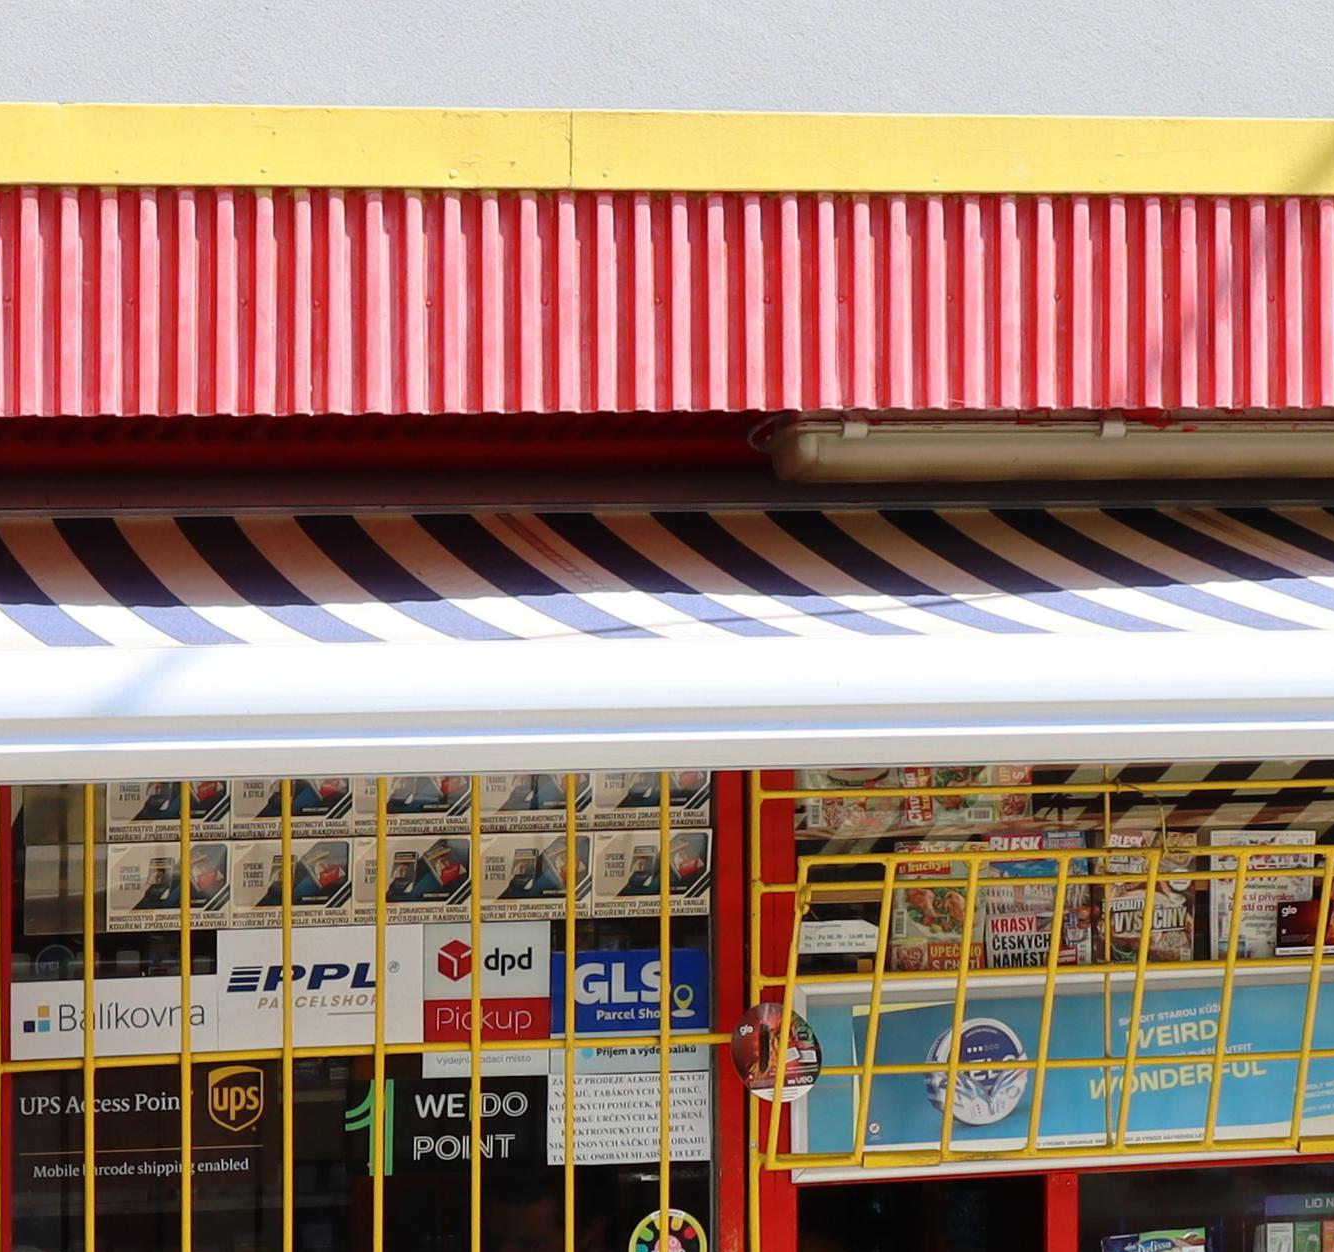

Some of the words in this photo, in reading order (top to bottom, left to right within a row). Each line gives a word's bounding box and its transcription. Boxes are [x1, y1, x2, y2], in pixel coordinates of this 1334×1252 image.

[1114, 906, 1187, 934] VYSČINY
[1281, 905, 1298, 918] glo
[991, 914, 1035, 933] KRÁSY
[992, 931, 1053, 952] ČESKÝCH
[930, 944, 983, 959] UPEČNO
[993, 951, 1049, 969] NÁMĚST
[484, 946, 533, 976] dpd
[944, 958, 982, 970] CHTÍ
[263, 961, 377, 993] PPL
[574, 961, 671, 1005] GLS
[258, 993, 378, 1010] PACELSHOP
[436, 1006, 533, 1034] Pickup
[596, 1008, 635, 1021] Parcel
[1119, 1013, 1156, 1027] SHDIT
[1158, 1008, 1197, 1022] STAROU
[739, 1023, 754, 1037] glo
[1125, 1019, 1221, 1050] WEIRD
[505, 1053, 532, 1064] místo
[637, 1046, 662, 1058] výde
[585, 1076, 625, 1086] PRODEJE
[1090, 1061, 1268, 1100] WONDERFUL
[593, 1086, 655, 1099] TABÁKOVÝCH
[20, 1095, 62, 1116] UPS
[135, 1090, 184, 1112] Poin
[213, 1085, 259, 1121] ups
[596, 1111, 646, 1123] URČENÝCH
[413, 1132, 516, 1161] POINT
[620, 1136, 650, 1148] SÁČKŮ
[670, 1135, 708, 1147] OBSAHU
[590, 1150, 630, 1162] OSOBÁM
[33, 1163, 80, 1179] Mobile
[198, 1157, 249, 1173] enabled
